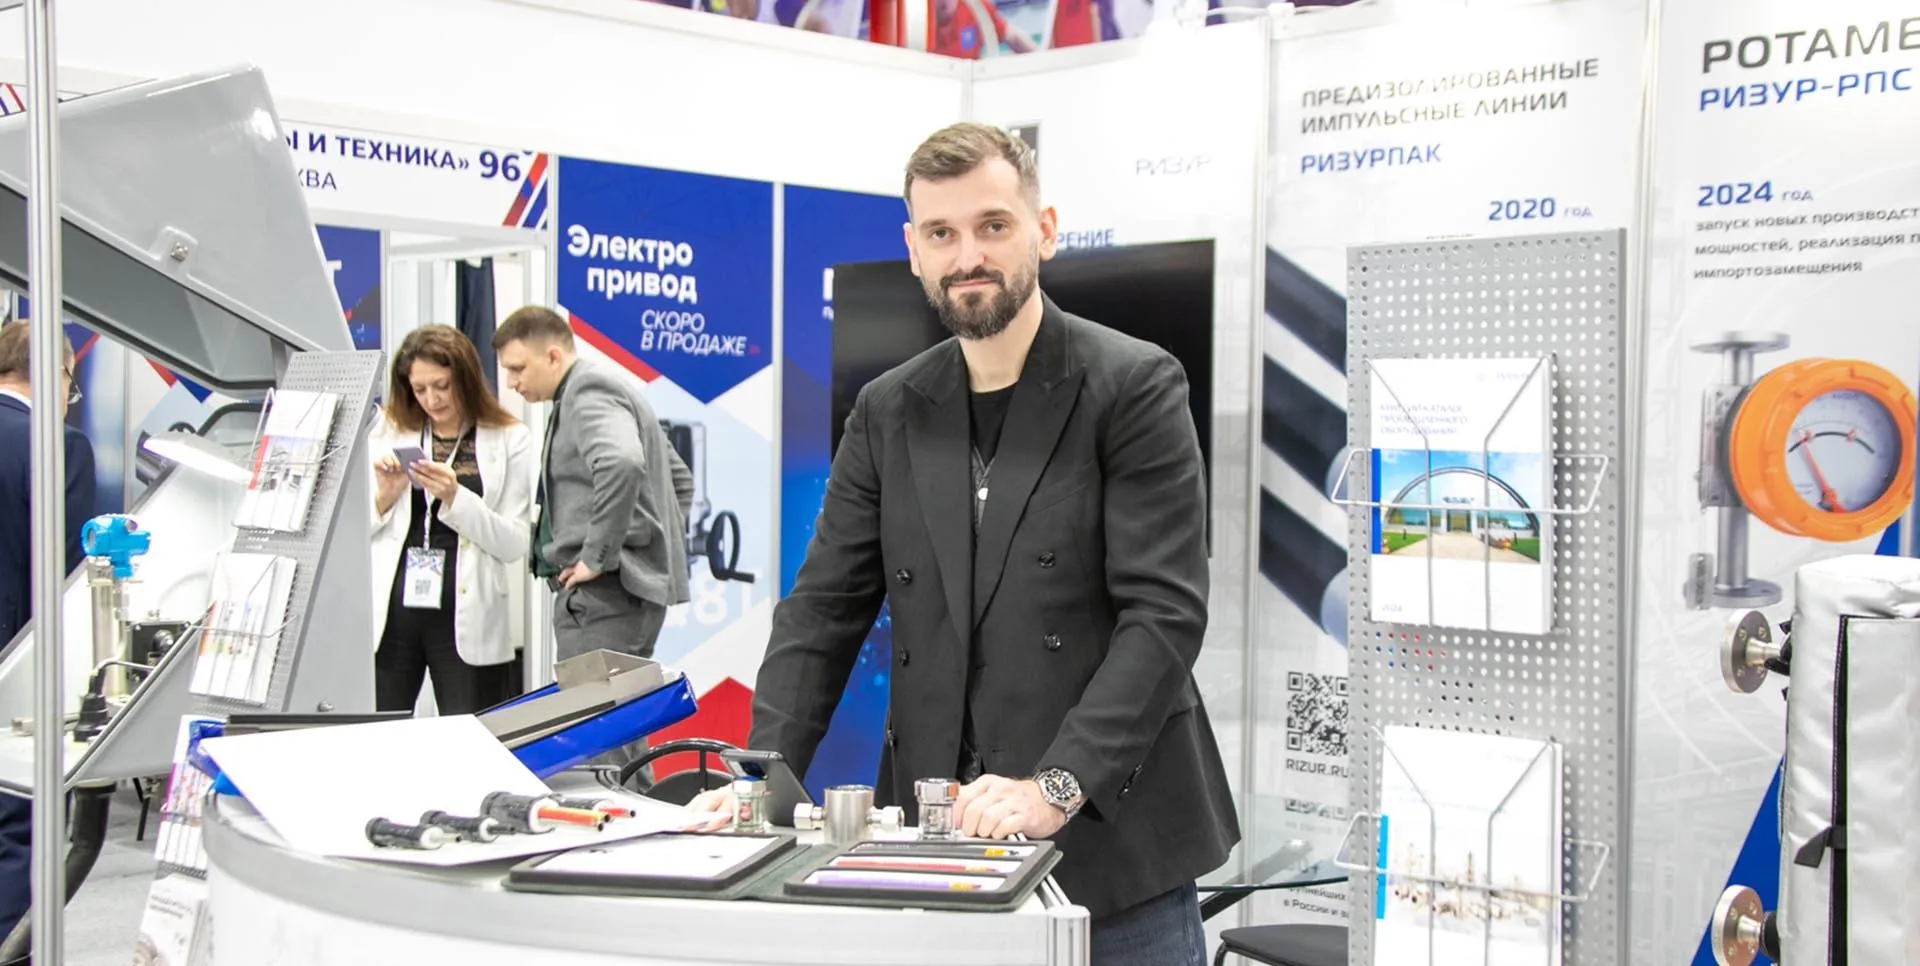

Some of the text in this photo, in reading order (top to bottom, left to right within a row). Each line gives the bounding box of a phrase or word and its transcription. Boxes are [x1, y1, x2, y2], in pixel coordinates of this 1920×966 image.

[1301, 57, 1600, 108] ПРЕДИЗОЛИРОВАННЫЕ
[1699, 68, 1912, 111] РИЗУР-РПС
[1301, 90, 1568, 134] ИМПУЛЬСНЫЕ ЛИНИИ
[308, 132, 327, 154] И
[335, 135, 470, 171] ТЕХНИКА»
[479, 149, 522, 183] 96
[1300, 143, 1442, 174] РИЗУРПАК
[1697, 180, 1814, 208] 2024 год
[1488, 198, 1593, 221] 2020 год
[1696, 218, 1750, 232] запуск
[1755, 214, 1808, 228] новых
[567, 224, 694, 269] Электро
[1798, 232, 1905, 250] реализация
[1694, 260, 1863, 281] импортозамещения
[587, 267, 698, 303] привод
[641, 309, 705, 335] СКОРО
[641, 330, 748, 357] В ПРОДАЖЕ
[1286, 758, 1349, 778] RIZUR.RU
